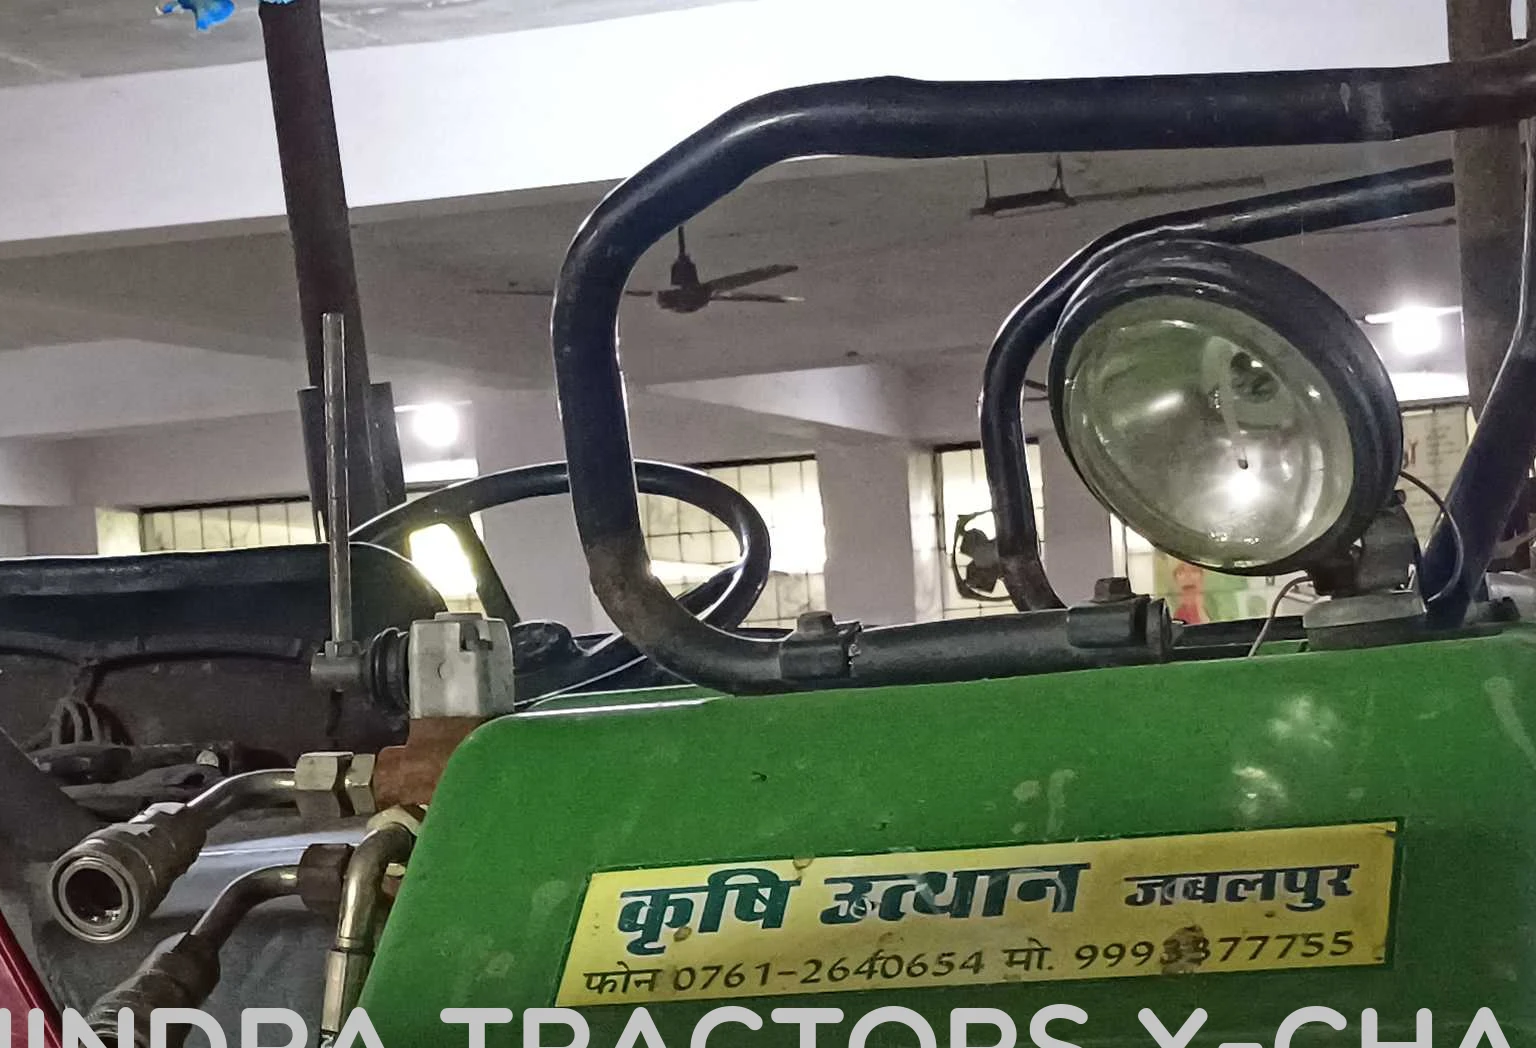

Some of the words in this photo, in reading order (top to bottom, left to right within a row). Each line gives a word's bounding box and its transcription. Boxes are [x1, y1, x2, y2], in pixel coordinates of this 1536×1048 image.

[617, 867, 801, 957] कृषि
[819, 862, 1092, 926] उत्थान
[1123, 863, 1360, 913] जबलपुर
[583, 961, 661, 995] फोन
[673, 947, 984, 994] 0761-2640654
[1003, 937, 1055, 972] मो.
